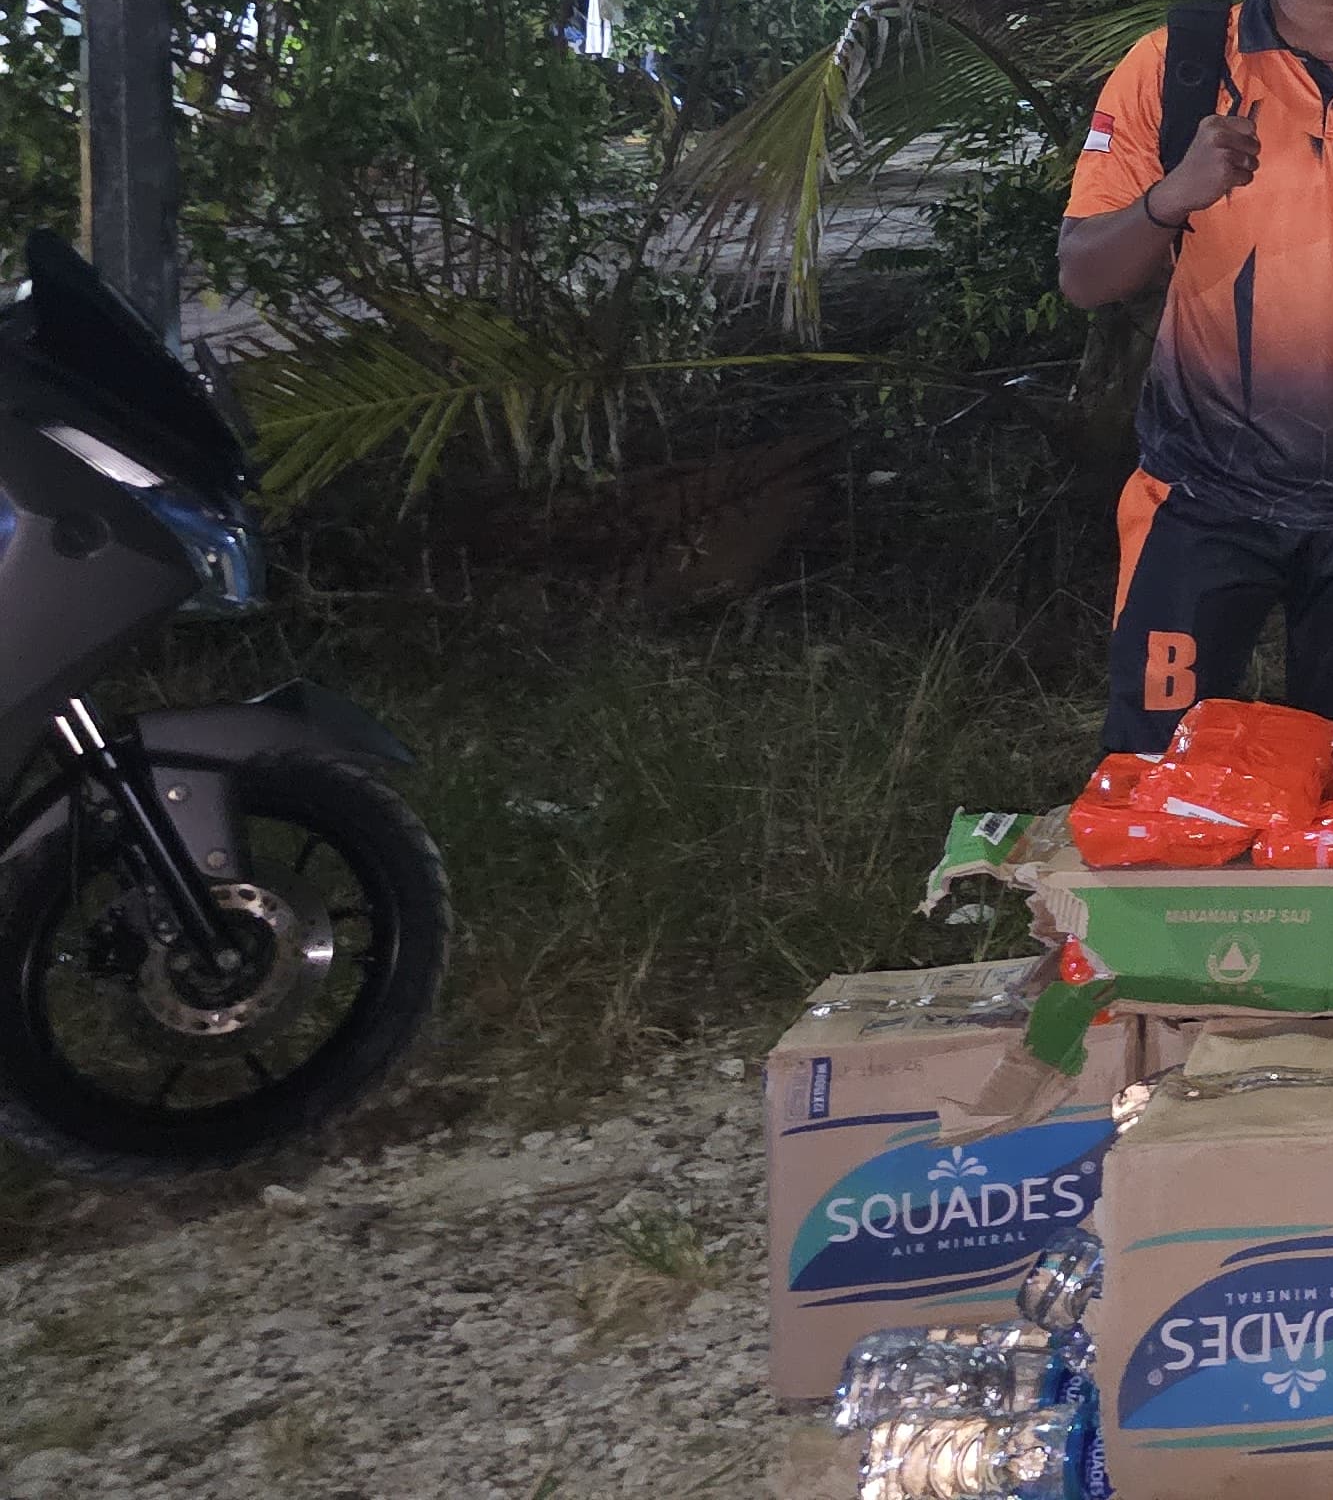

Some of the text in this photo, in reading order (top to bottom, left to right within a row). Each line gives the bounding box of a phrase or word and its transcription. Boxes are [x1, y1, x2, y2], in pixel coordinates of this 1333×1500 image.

[1144, 631, 1197, 711] B
[826, 1174, 1085, 1243] SQUADES
[891, 1231, 1026, 1257] AIR MINERAL
[1225, 1286, 1317, 1305] MINERAL
